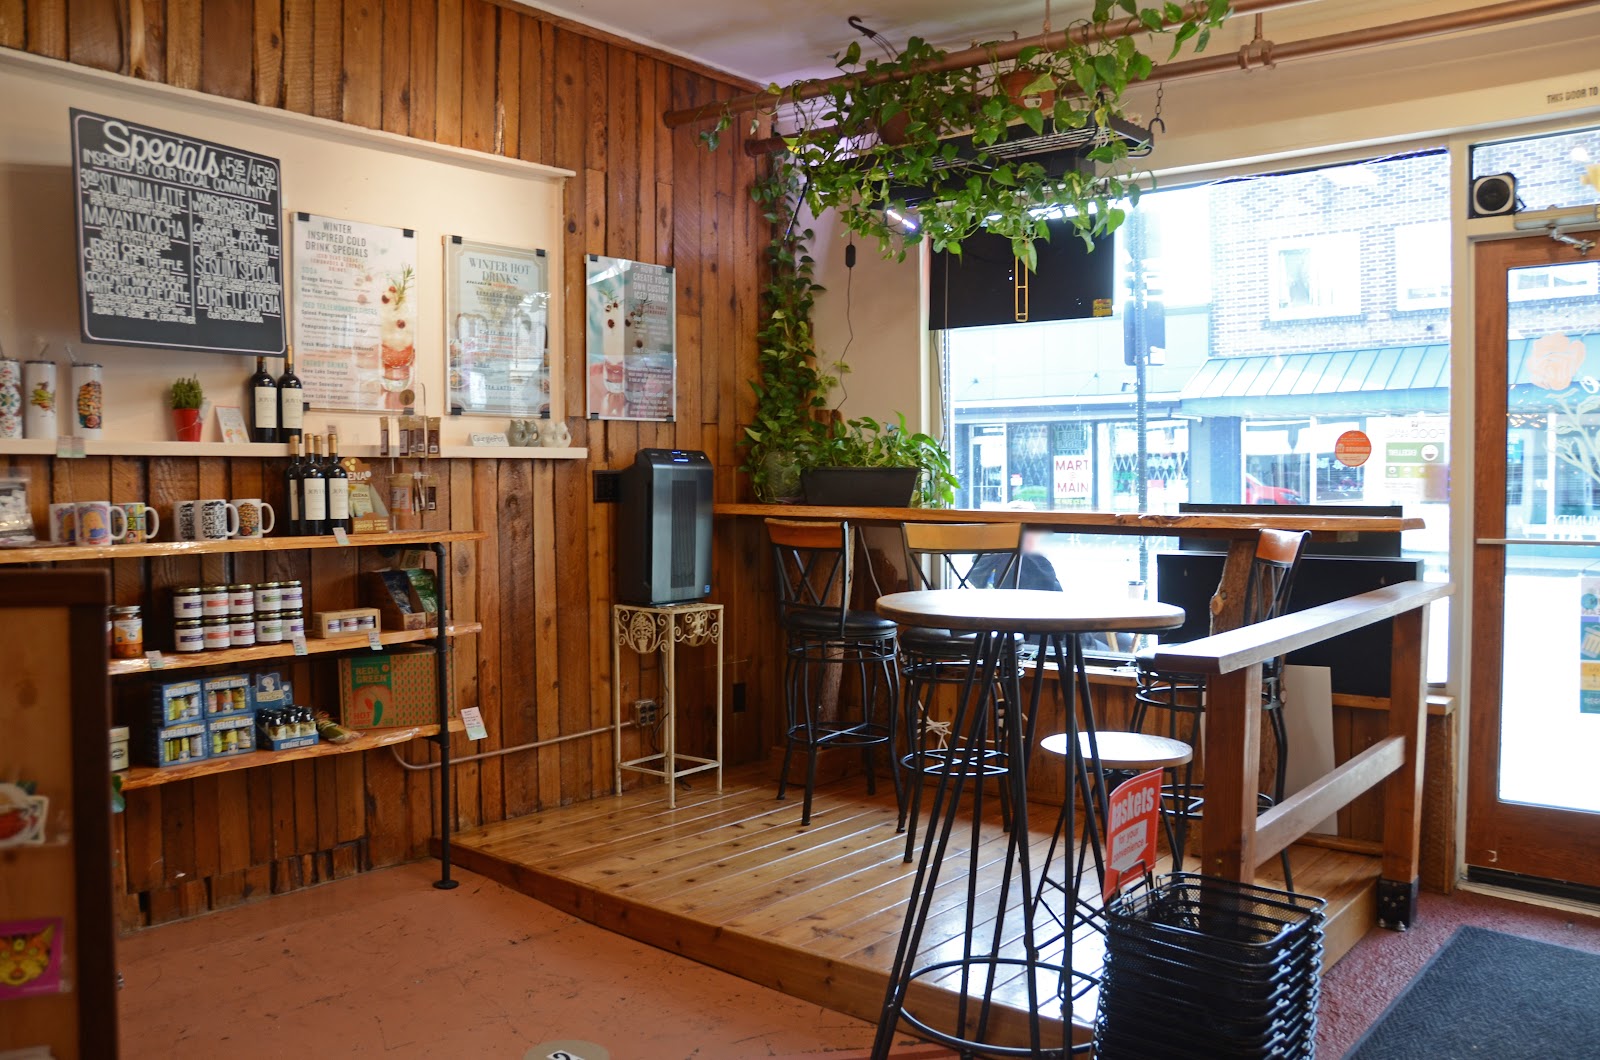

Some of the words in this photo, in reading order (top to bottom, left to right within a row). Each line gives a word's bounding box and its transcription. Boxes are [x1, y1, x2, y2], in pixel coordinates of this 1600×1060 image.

[1547, 93, 1563, 104] THIS
[1565, 89, 1587, 101] DOOR
[1589, 86, 1599, 96] TO
[103, 121, 220, 178] Specials
[83, 150, 131, 171] INSPIRED
[136, 161, 150, 175] BY
[152, 164, 178, 181] OUR
[180, 170, 210, 188] LOCAL
[214, 178, 270, 200] COMMUNITY
[114, 175, 153, 200] VANILLA
[154, 183, 186, 206] LATTE
[192, 200, 246, 219] WILDFLOWER
[248, 210, 274, 225] LATTE
[196, 192, 258, 213] WASHINGTON
[84, 204, 134, 230] MAYAN
[136, 213, 185, 238] MOCHA
[323, 222, 352, 233] WINTER
[192, 232, 224, 246] BROWN
[225, 237, 254, 251] BETTY
[254, 242, 279, 254] LATTE
[193, 223, 233, 238] CARAMEL
[238, 231, 268, 244] APPLE
[307, 230, 343, 243] INSPIRED
[346, 236, 366, 246] COLD
[90, 238, 119, 252] IRISH
[121, 243, 161, 258] CREME
[305, 241, 330, 252] DRINK
[332, 245, 368, 257] SPECIALS
[84, 247, 139, 264] CHOCOLATE
[142, 255, 183, 270] TRUFFLE
[468, 257, 508, 272] WINTER
[510, 263, 531, 275] HOT
[194, 255, 237, 278] SEQUIM
[238, 262, 278, 284] SPECIAL
[481, 270, 518, 285] DRINKS
[632, 272, 654, 284] CREATE
[655, 276, 670, 286] YOUR
[655, 266, 663, 276] TO
[85, 271, 131, 285] COCONUT
[132, 277, 183, 291] MACAROON
[632, 281, 647, 291] OWN
[648, 283, 670, 295] CUSTOM
[86, 281, 114, 294] WHITE
[114, 284, 163, 300] CHOCOLATE
[164, 290, 190, 302] LATTE
[196, 286, 244, 309] BURNETT
[245, 292, 280, 313] BORGIA
[633, 290, 648, 301] ICED
[648, 292, 669, 304] DRINKS
[1055, 459, 1089, 471] MART
[347, 471, 367, 481] ENA
[1057, 482, 1089, 493] MAIN
[355, 674, 388, 684] GREEN
[1110, 786, 1155, 834] baskets
[1118, 833, 1127, 846] for
[1126, 827, 1139, 842] your
[1113, 838, 1145, 863] convenience
